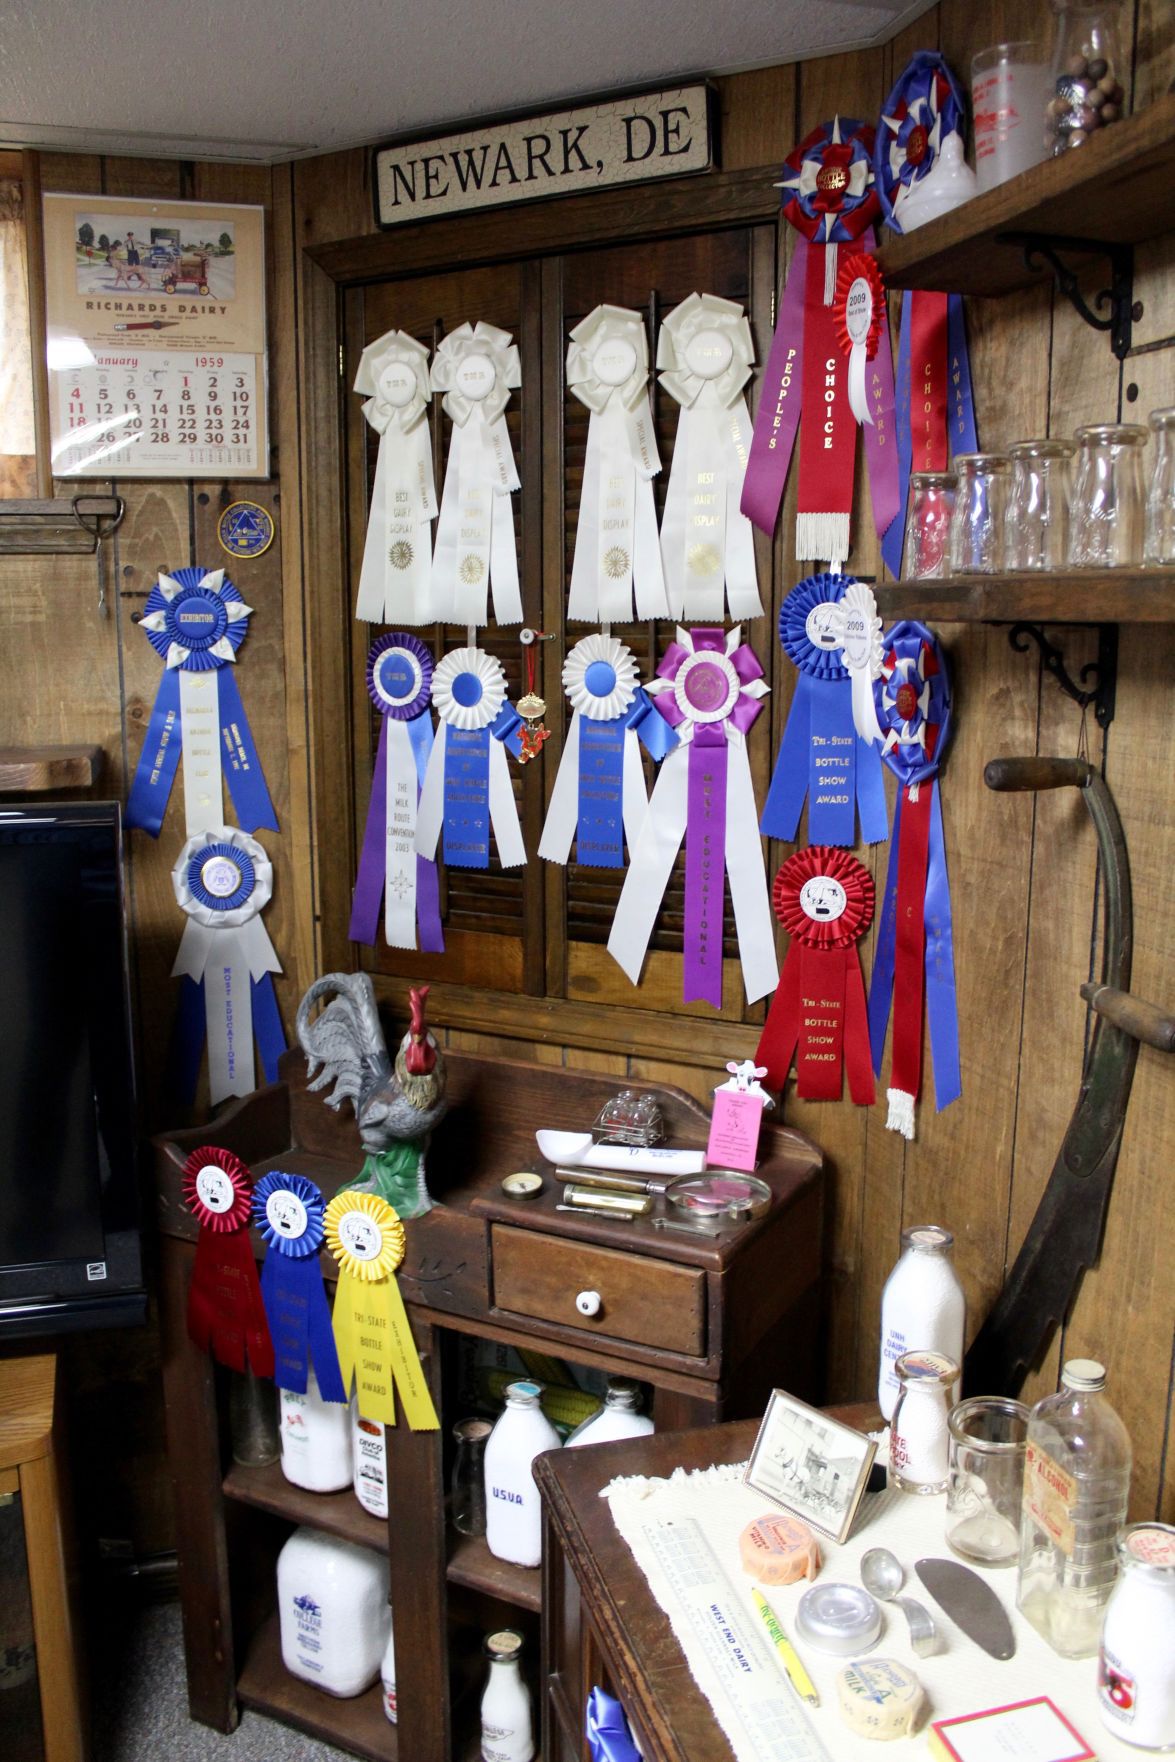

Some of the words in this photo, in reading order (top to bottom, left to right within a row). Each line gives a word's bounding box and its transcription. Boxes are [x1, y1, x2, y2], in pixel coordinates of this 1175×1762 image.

[390, 125, 604, 207] NEWARK,
[621, 106, 693, 164] DE
[850, 292, 866, 306] 2009
[86, 301, 168, 312] RICHARDS
[178, 304, 227, 315] DAIRY
[94, 353, 138, 368] anuary
[195, 356, 223, 368] 1959
[183, 376, 189, 387] 1
[208, 377, 218, 388] 2
[235, 377, 245, 388] 3
[71, 388, 81, 399] 4
[99, 388, 108, 400] 5
[126, 389, 136, 400] 6
[154, 389, 163, 400] 7
[181, 389, 191, 401] 8
[208, 390, 218, 401] 9
[232, 391, 249, 402] 10
[769, 349, 796, 449] PEOPLE'S
[952, 357, 965, 434] AWARD
[69, 402, 84, 413] 11
[96, 403, 113, 414] 12
[123, 403, 141, 414] 13
[152, 404, 168, 415] 14
[179, 404, 196, 415] 15
[206, 405, 223, 416] 16
[232, 405, 249, 416] 17
[824, 358, 836, 449] CHOICE
[871, 374, 885, 446] AWARD
[69, 416, 86, 428] 18
[123, 418, 142, 429] 20
[150, 418, 167, 429] 21
[177, 419, 196, 430] 22
[204, 419, 223, 430] 23
[231, 419, 250, 430] 24
[924, 363, 932, 469] CHOICE
[96, 431, 115, 443] 26
[150, 432, 170, 443] 28
[178, 432, 197, 444] 29
[204, 432, 224, 444] 30
[231, 433, 248, 444] 31
[697, 473, 714, 484] BEST
[395, 492, 408, 502] BEST
[694, 495, 716, 505] DAIRY
[389, 524, 413, 534] DISPLAY
[603, 519, 629, 531] DISPLAY
[847, 620, 864, 631] 2009
[815, 758, 850, 767] BOTTLE
[397, 782, 408, 793] THE
[818, 776, 847, 785] SHOW
[395, 798, 409, 809] MILK
[703, 773, 713, 820] MOST
[815, 794, 849, 804] AWARD
[393, 813, 411, 824] ROUTE
[387, 827, 415, 839] CONVENTION
[395, 842, 410, 853] 2003
[699, 834, 713, 966] EDUCATIONAL
[804, 1018, 838, 1028] BOTTLE
[225, 1000, 235, 1080] EDUCATIONAL
[807, 1035, 834, 1044] SHOW
[804, 1053, 836, 1062] AWARD
[360, 1336, 382, 1351] BOTTLE
[362, 1358, 382, 1373] SHOW
[362, 1382, 387, 1396] AWARD
[359, 1438, 383, 1452] DIVCO
[1038, 1461, 1069, 1501] ALCOHOL
[749, 1532, 762, 1548] MILK
[710, 1604, 726, 1624] WEST
[722, 1628, 736, 1644] END
[733, 1647, 752, 1673] DAIRY
[844, 1670, 866, 1694] MILK
